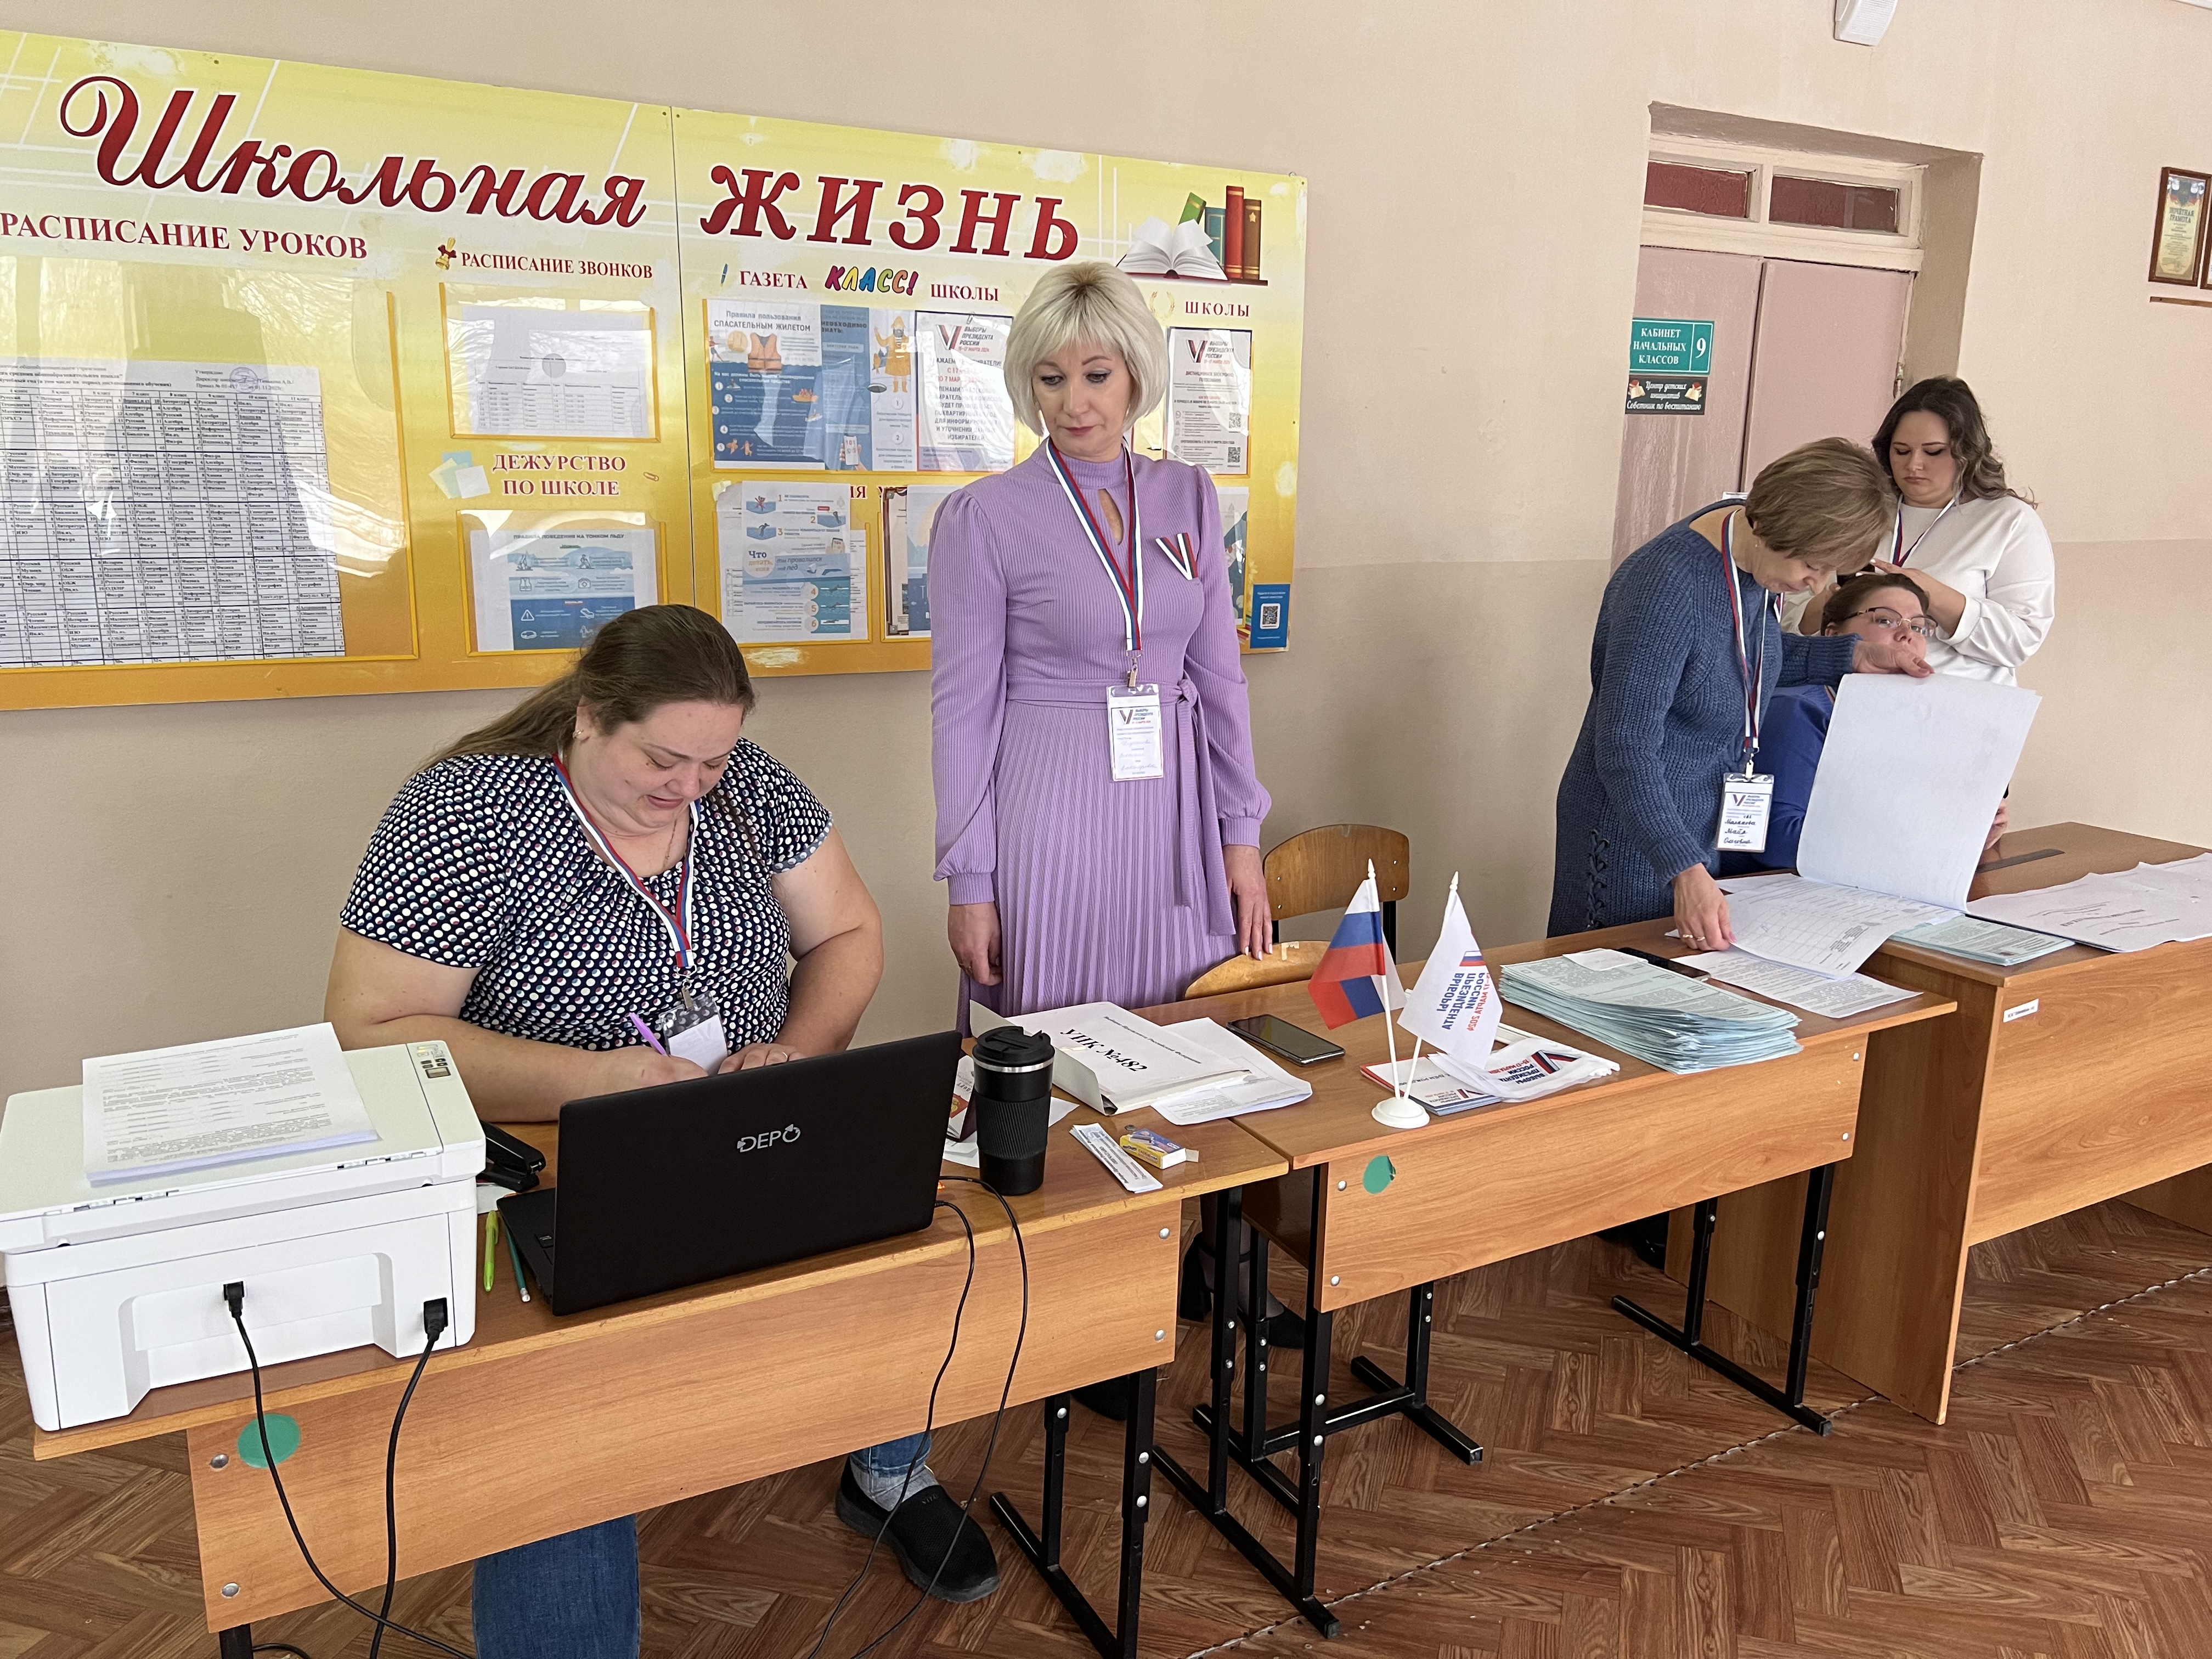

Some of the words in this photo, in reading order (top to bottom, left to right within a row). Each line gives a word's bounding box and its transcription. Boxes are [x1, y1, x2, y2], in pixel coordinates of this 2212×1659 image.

[60, 76, 647, 227] Школьная
[0, 212, 230, 252] РАСПИСАНИЕ
[241, 225, 368, 260] УРОКОВ
[461, 251, 574, 275] РАСПИСАНИЕ
[578, 257, 653, 279] ЗВОНКОВ
[739, 270, 808, 289] ГАЗЕТА
[825, 265, 919, 296] КЛАСС!
[930, 284, 999, 302] ШКОЛЫ
[1185, 301, 1250, 317] ШКОЛЫ
[714, 320, 773, 330] СПАСАТЕЛЬНЫМ
[776, 323, 810, 331] ЖИЛЕТОМ
[1641, 328, 1681, 338] КАБИНЕТ
[1633, 341, 1686, 352] НАЧАЛЬНЫХ
[1695, 338, 1706, 358] 9
[1639, 355, 1679, 364] КЛАССОВ
[1627, 400, 1655, 409] Советник
[493, 454, 626, 472] ДЕЖУРСТВО
[503, 480, 534, 495] ПО
[541, 480, 619, 495] ШКОЛЕ
[1060, 1029, 1104, 1049] УИК
[1096, 1049, 1148, 1071] №482
[737, 1124, 801, 1152] DEPO
